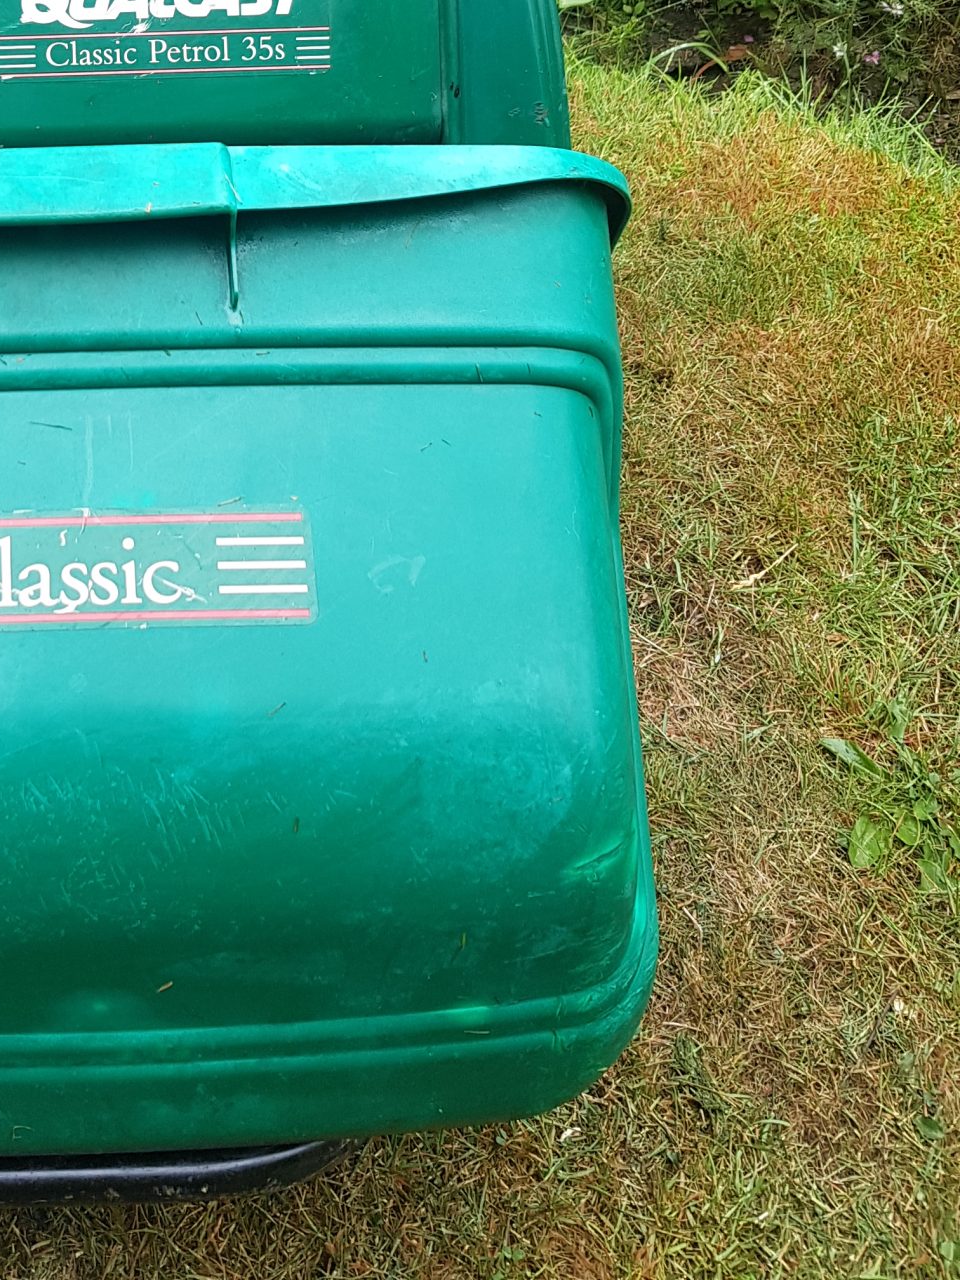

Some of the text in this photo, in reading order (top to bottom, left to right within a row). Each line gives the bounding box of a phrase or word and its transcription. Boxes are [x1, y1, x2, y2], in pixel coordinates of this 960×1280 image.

[45, 35, 286, 68] Classic Petrol 35s
